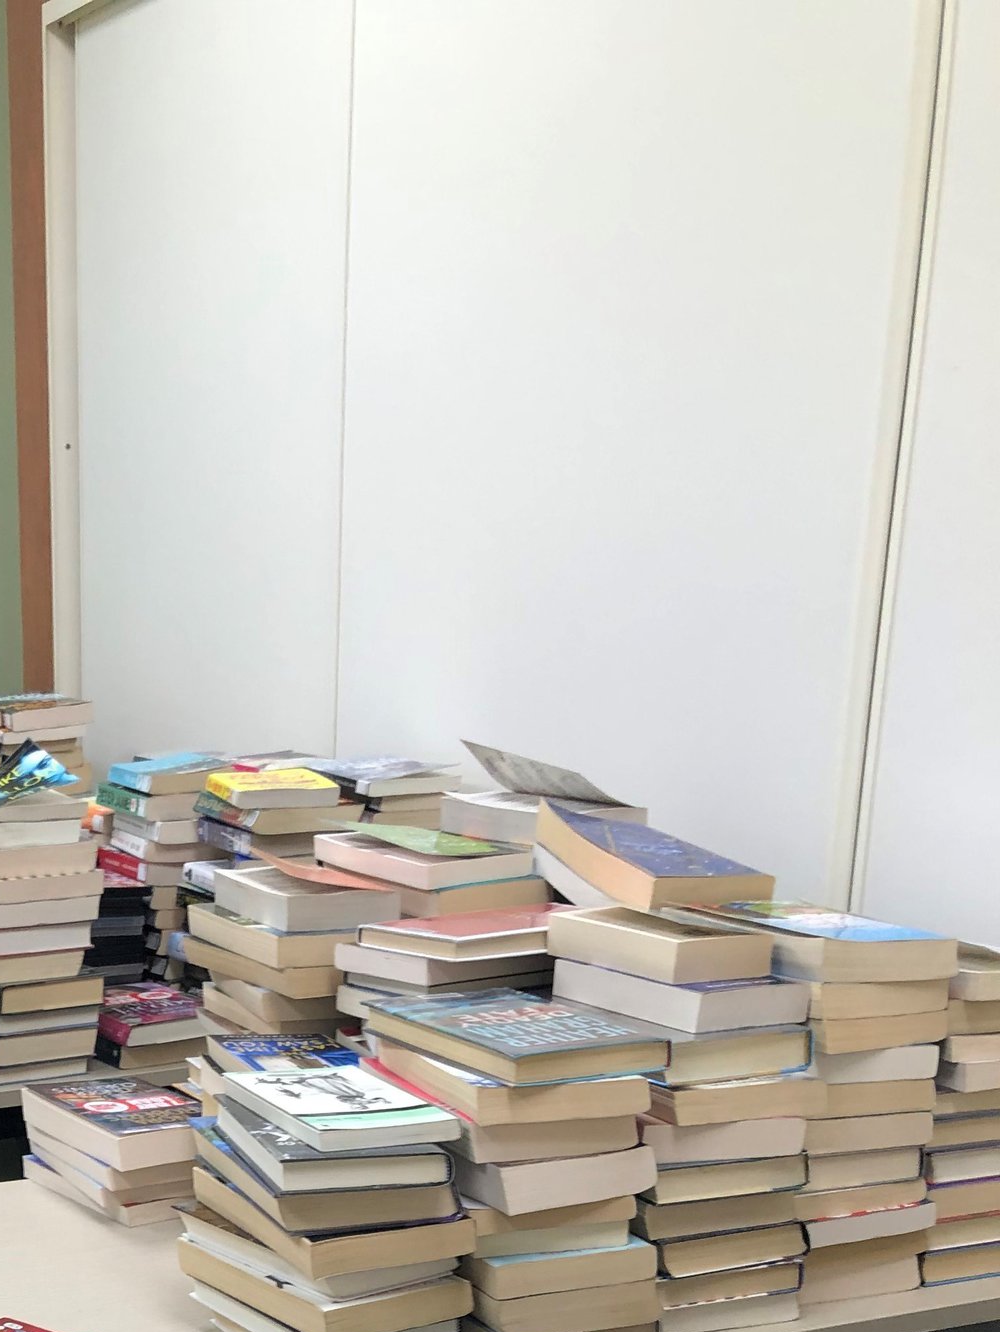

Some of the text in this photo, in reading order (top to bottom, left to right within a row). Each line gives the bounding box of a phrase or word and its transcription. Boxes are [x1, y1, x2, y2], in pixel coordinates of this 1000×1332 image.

[452, 1007, 540, 1024] FATE
[467, 1016, 609, 1038] GRAHAM
[494, 1025, 639, 1047] HEATHER
